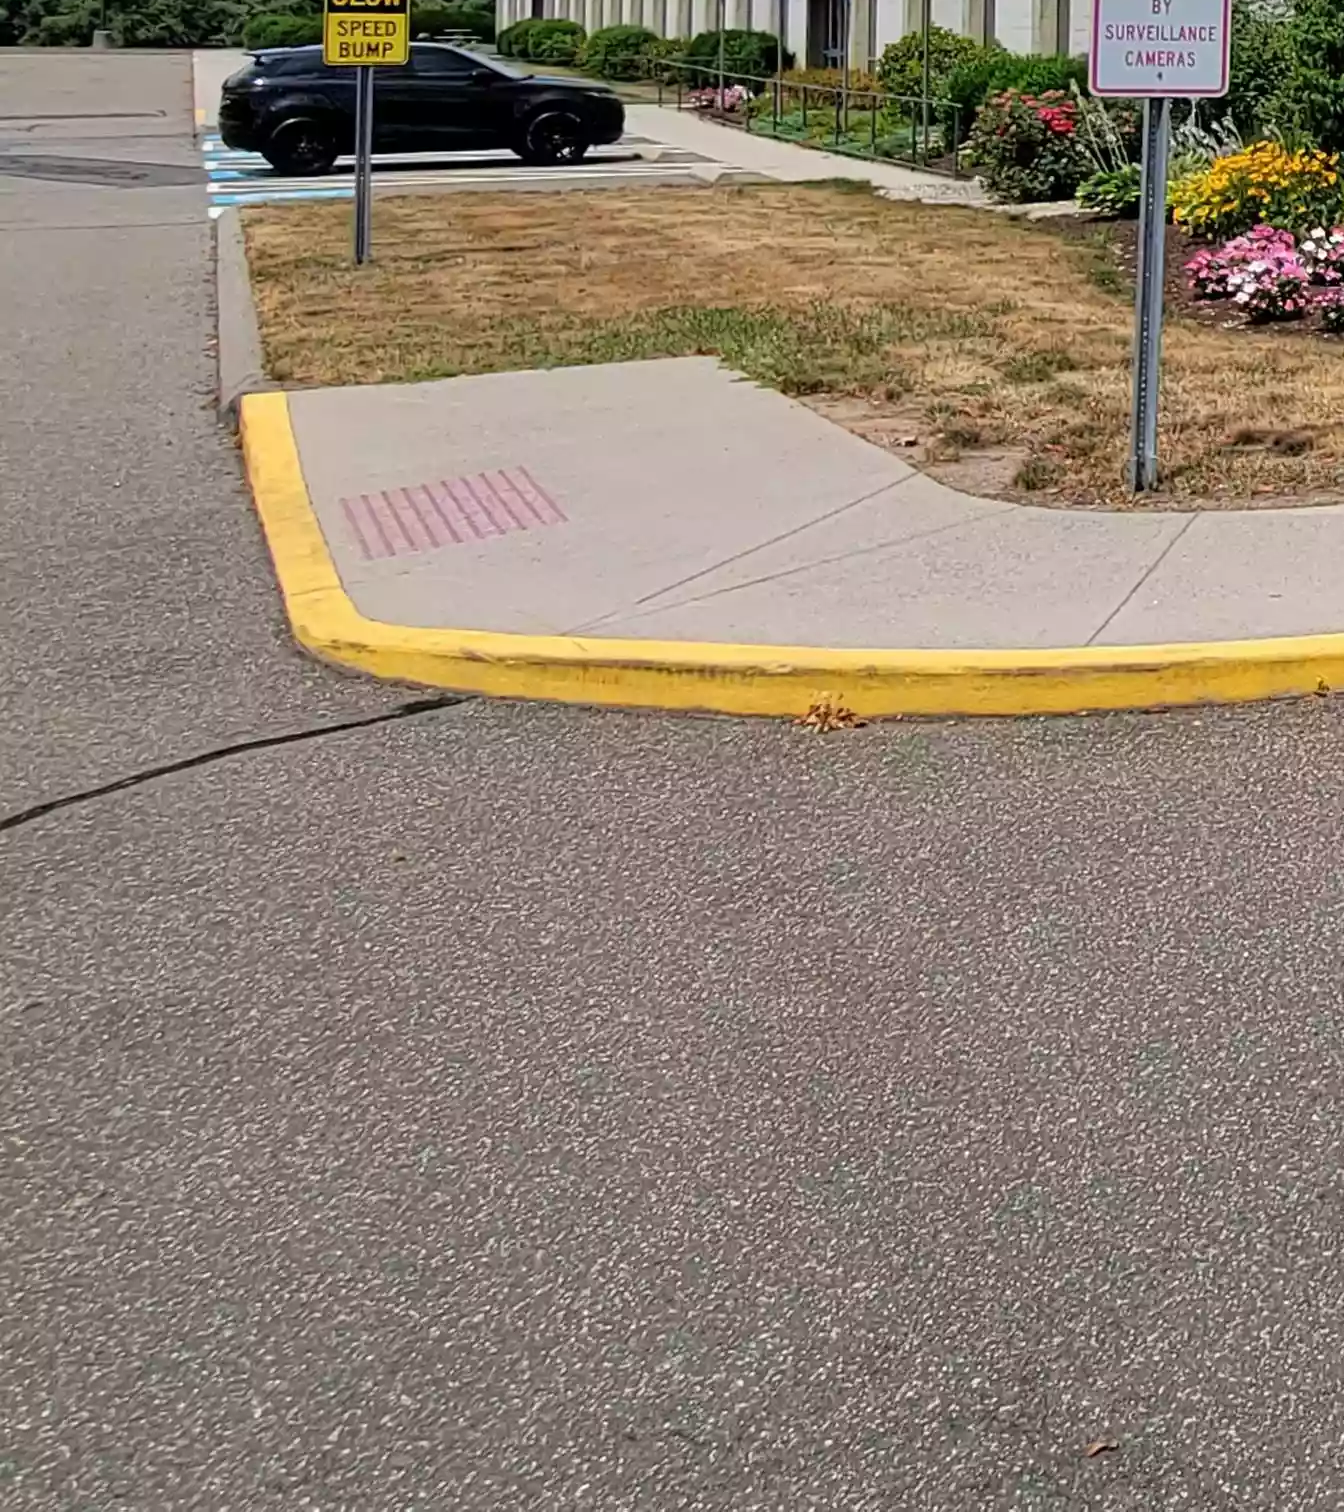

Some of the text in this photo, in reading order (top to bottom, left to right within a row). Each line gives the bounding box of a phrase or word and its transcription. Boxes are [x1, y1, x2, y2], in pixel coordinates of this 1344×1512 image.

[1151, 0, 1172, 15] BY
[336, 20, 397, 37] SPEED
[1104, 24, 1217, 43] SURVEILLANCE
[338, 41, 394, 59] BUMP
[1124, 51, 1196, 68] CAMERAS
